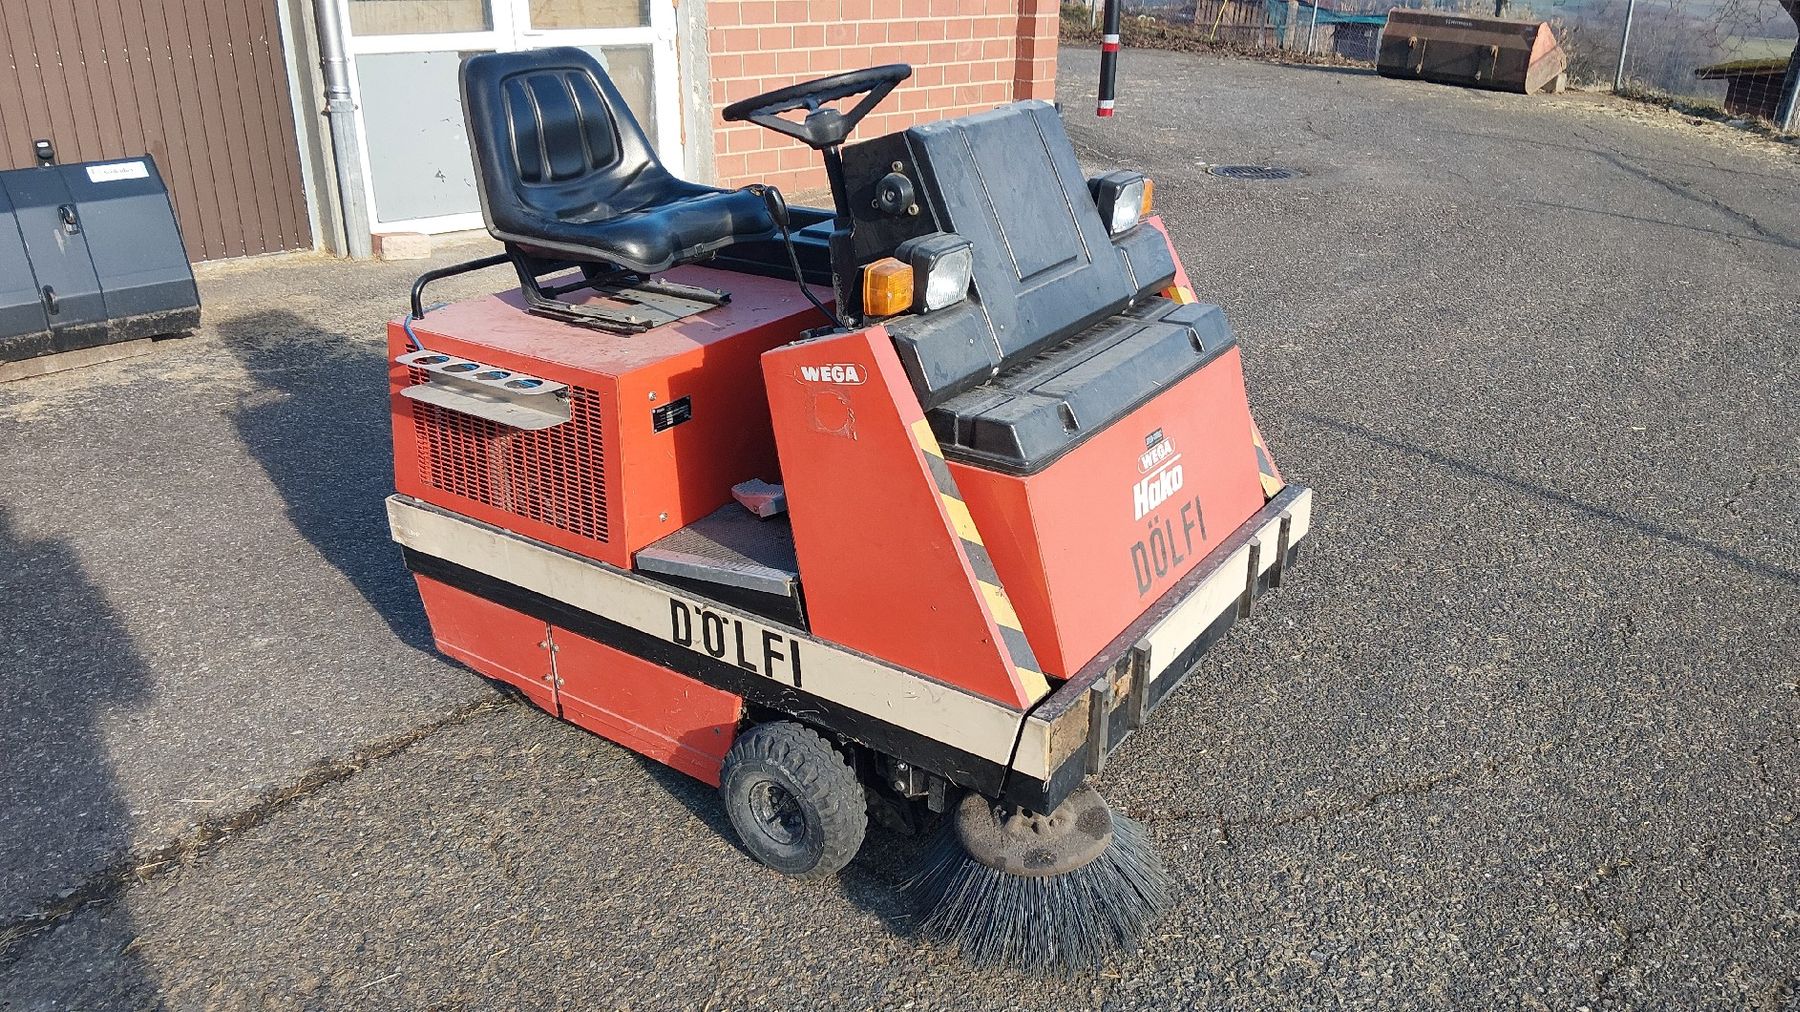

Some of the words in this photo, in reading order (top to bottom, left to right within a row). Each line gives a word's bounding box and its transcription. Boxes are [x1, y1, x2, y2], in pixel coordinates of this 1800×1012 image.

[801, 366, 860, 383] WEGA
[1141, 440, 1173, 469] WEGA
[1133, 464, 1184, 521] Hako
[1130, 495, 1207, 598] DÖLFI
